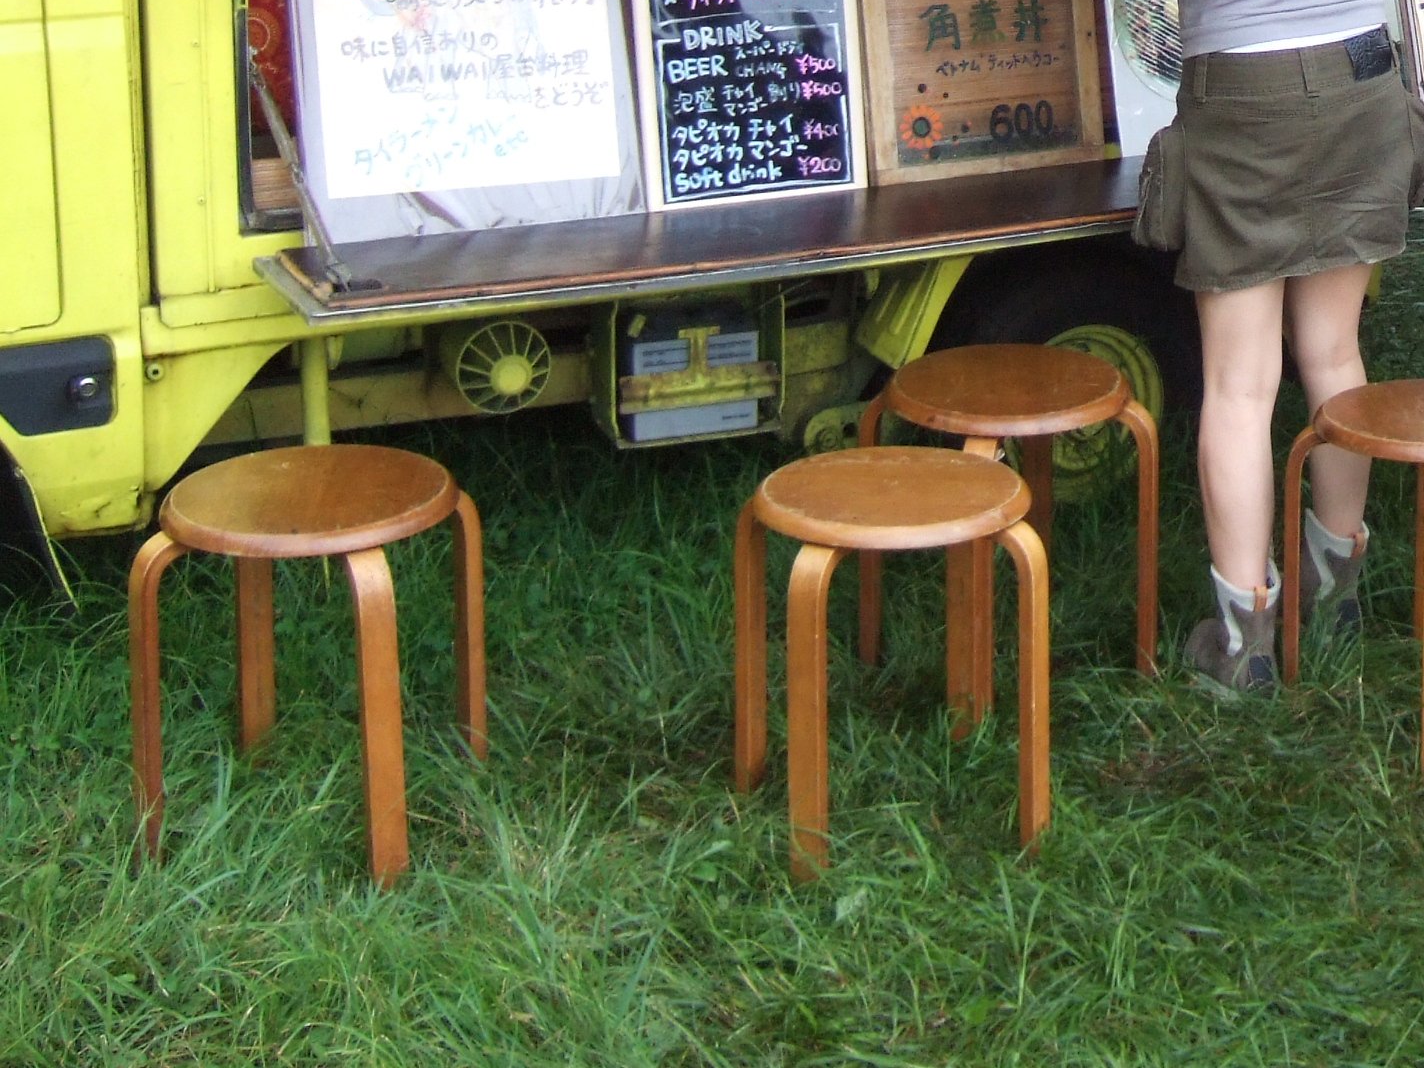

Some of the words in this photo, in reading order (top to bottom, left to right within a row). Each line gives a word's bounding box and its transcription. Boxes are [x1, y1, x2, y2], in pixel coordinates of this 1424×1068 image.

[683, 19, 764, 50] DRINK
[667, 55, 729, 83] BEER
[795, 53, 836, 74] ¥500
[672, 119, 741, 146] タピオカ
[989, 100, 1053, 142] 600
[673, 144, 744, 171] タピオカ
[728, 161, 783, 184] drink
[797, 156, 842, 176] ¥200
